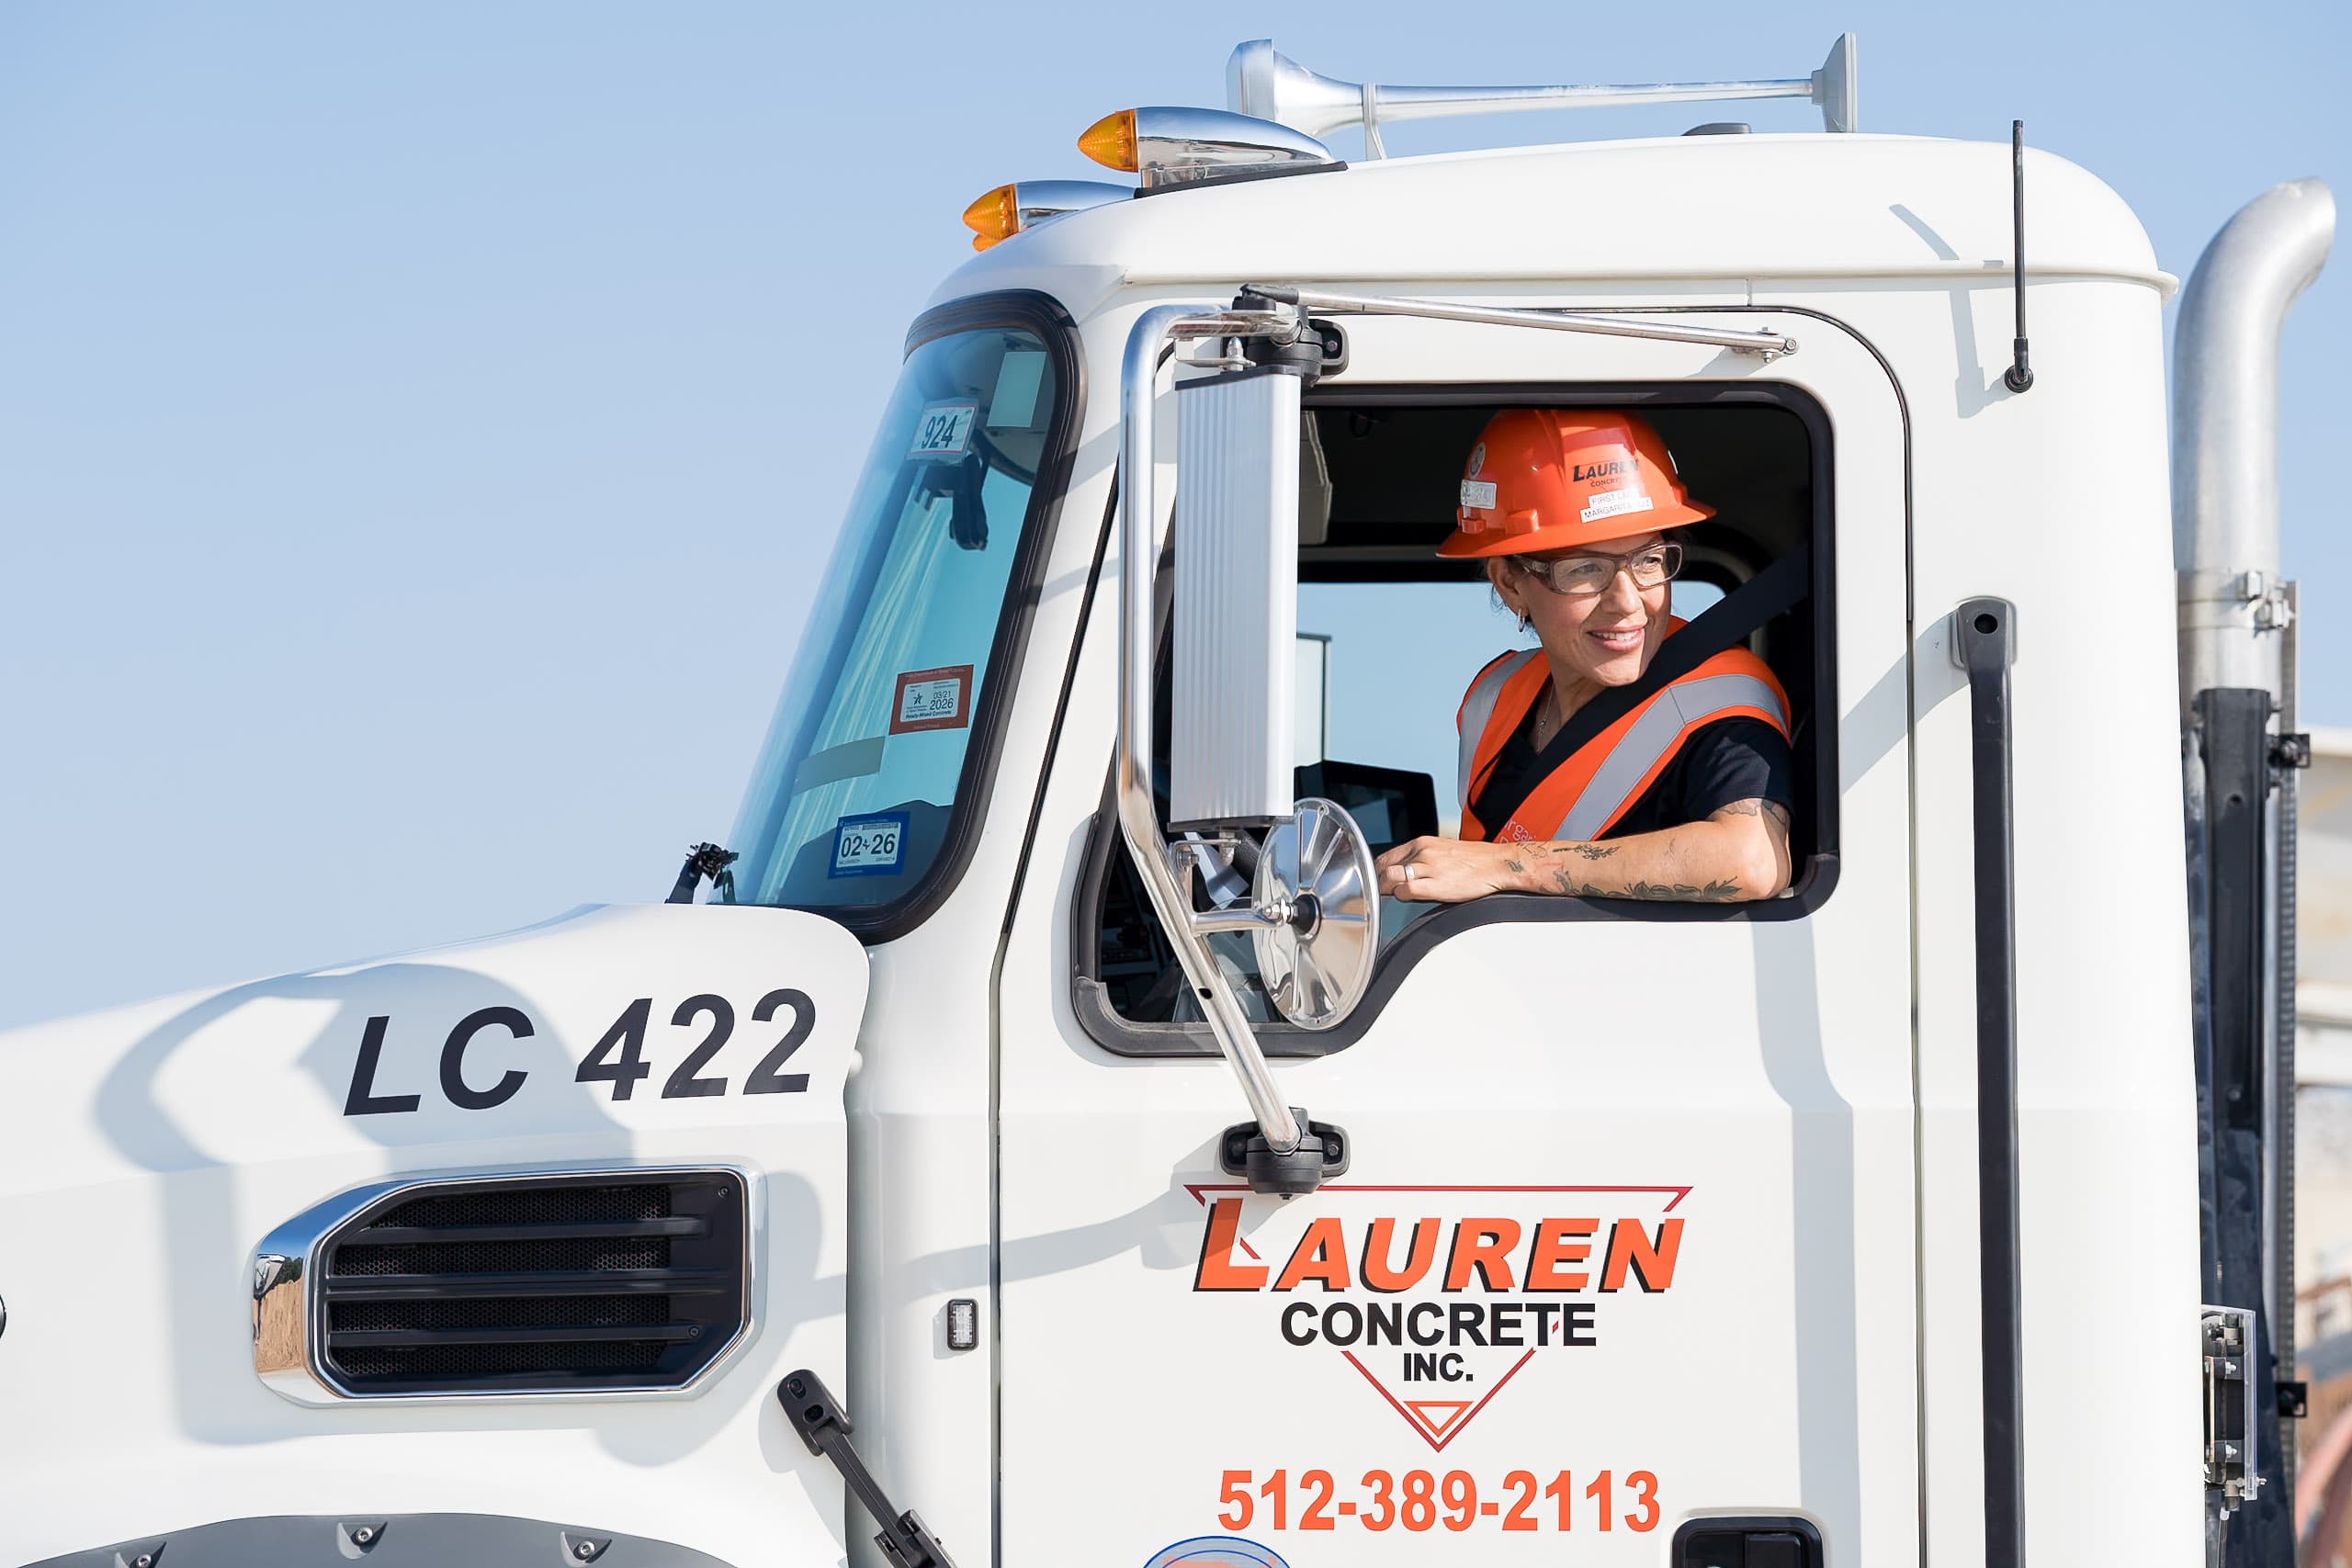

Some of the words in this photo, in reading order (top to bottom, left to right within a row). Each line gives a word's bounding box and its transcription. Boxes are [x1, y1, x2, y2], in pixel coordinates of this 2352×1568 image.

[922, 416, 958, 448] 924
[929, 697, 954, 711] 2026
[344, 1006, 535, 1116] LC
[575, 988, 816, 1100] 422
[1193, 1198, 1685, 1292] LAUREN
[1281, 1302, 1597, 1347] CONCRETE
[1403, 1353, 1474, 1382] INC.
[1217, 1469, 1661, 1532] 512-389-2113
